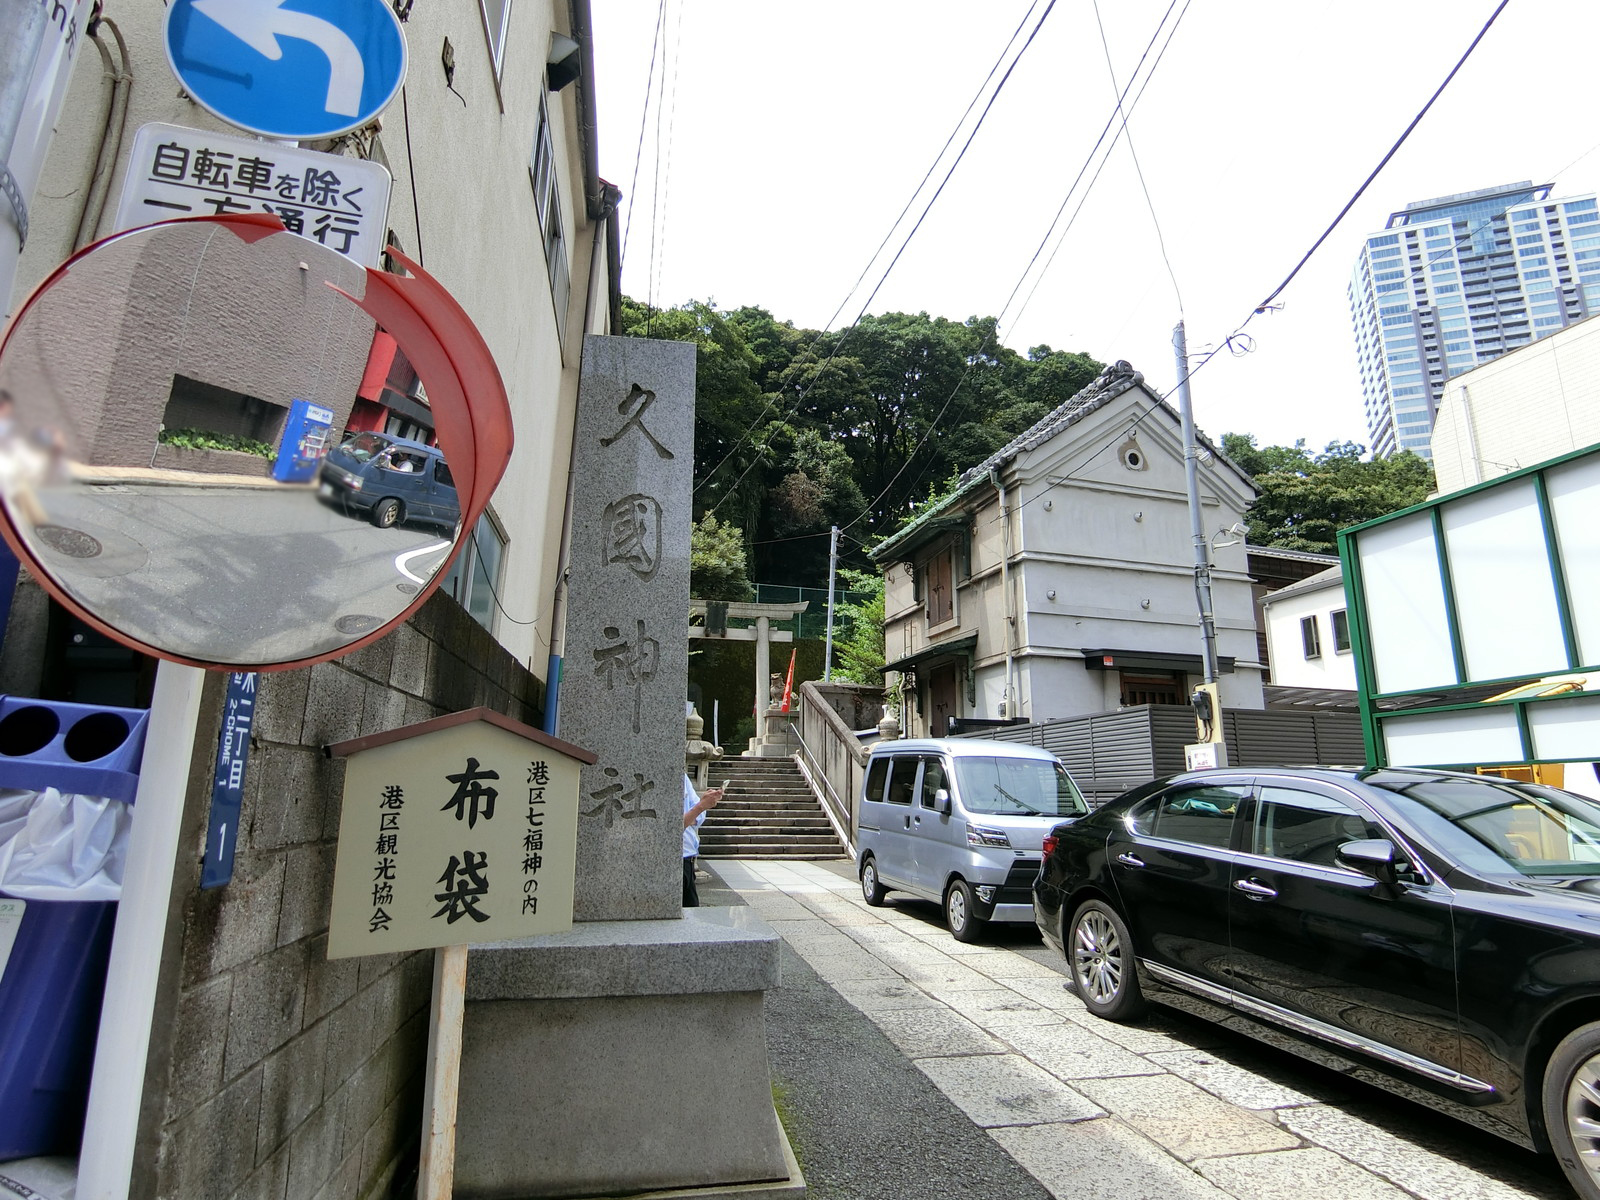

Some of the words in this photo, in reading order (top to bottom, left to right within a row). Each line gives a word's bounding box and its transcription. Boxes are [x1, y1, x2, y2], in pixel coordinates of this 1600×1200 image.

[152, 142, 363, 212] 自転車を除く
[581, 382, 674, 829] 久國神社
[221, 698, 238, 766] 2-CHOME
[368, 785, 404, 933] 港区観光協会
[430, 757, 500, 925] 布袋
[521, 760, 550, 915] 港区七福神の内
